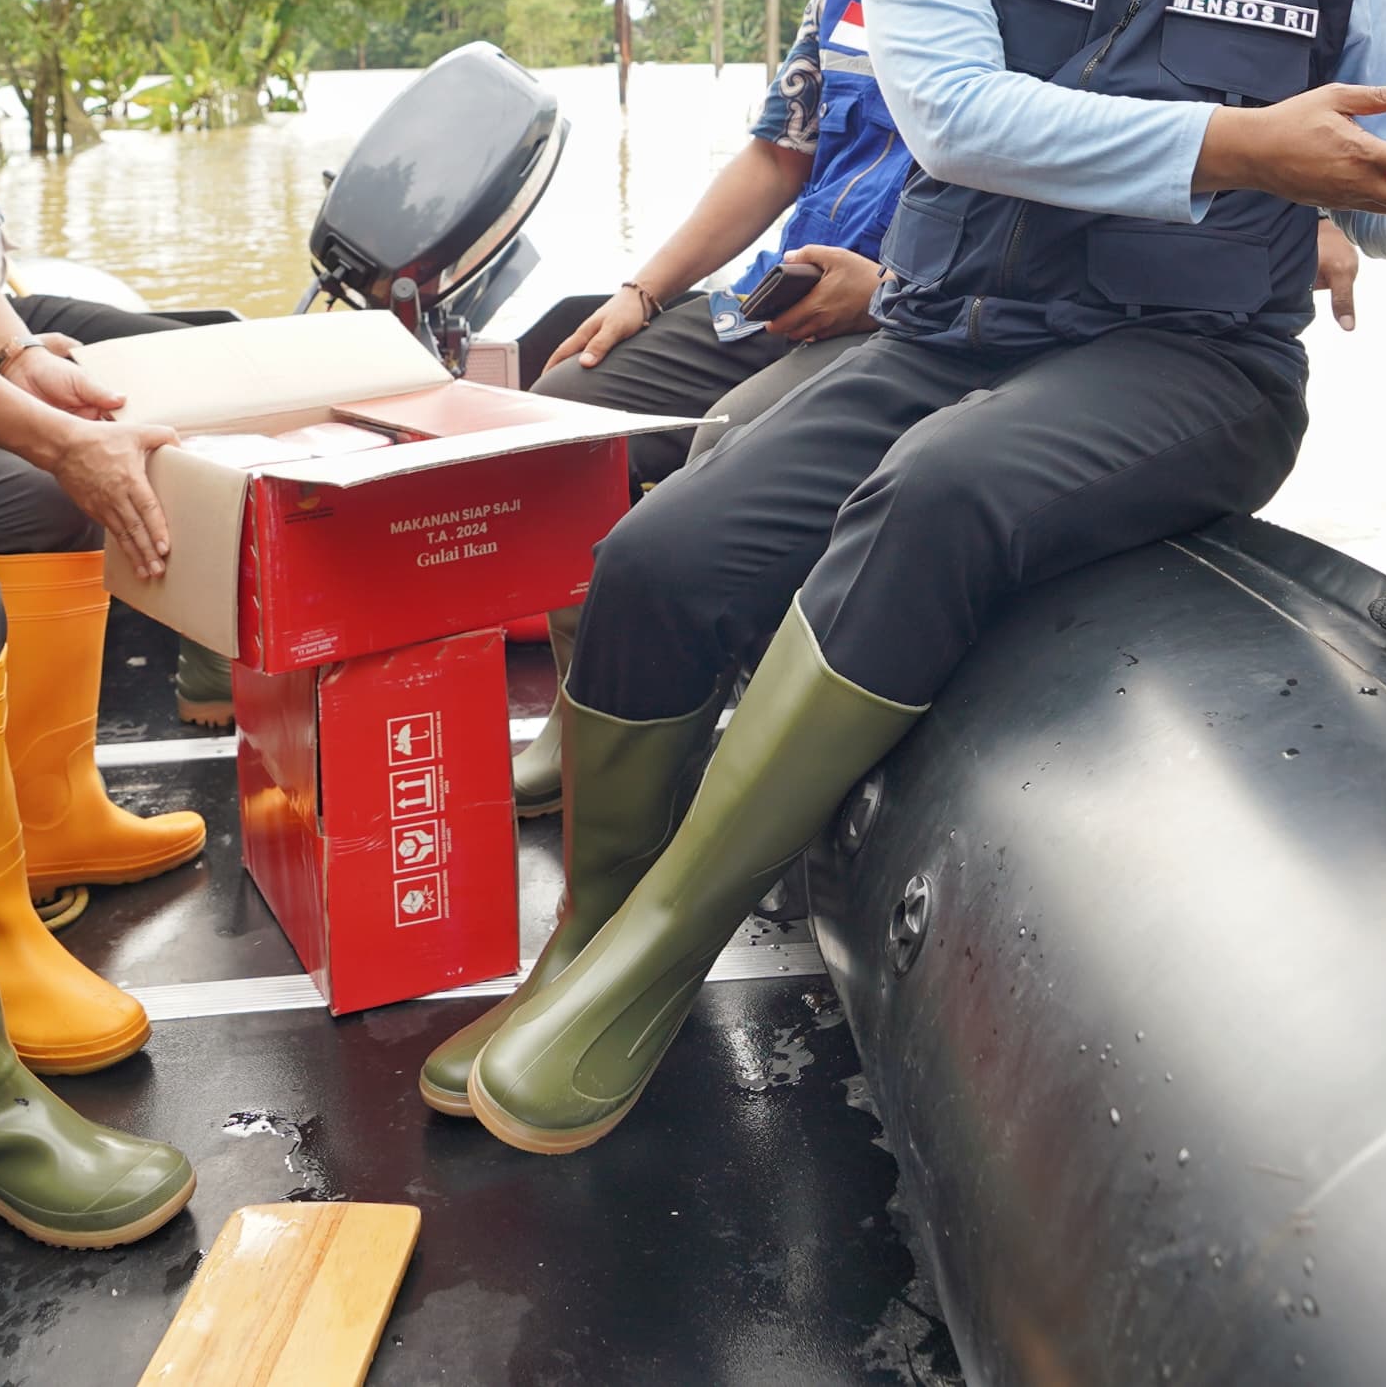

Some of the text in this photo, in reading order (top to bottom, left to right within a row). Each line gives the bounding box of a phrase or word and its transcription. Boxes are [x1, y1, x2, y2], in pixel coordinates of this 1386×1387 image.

[1284, 9, 1308, 31] RI
[390, 498, 521, 534] MAKANAN SIAP SAJI
[456, 521, 488, 539] 2024
[416, 541, 498, 567] Gulai Ikan
